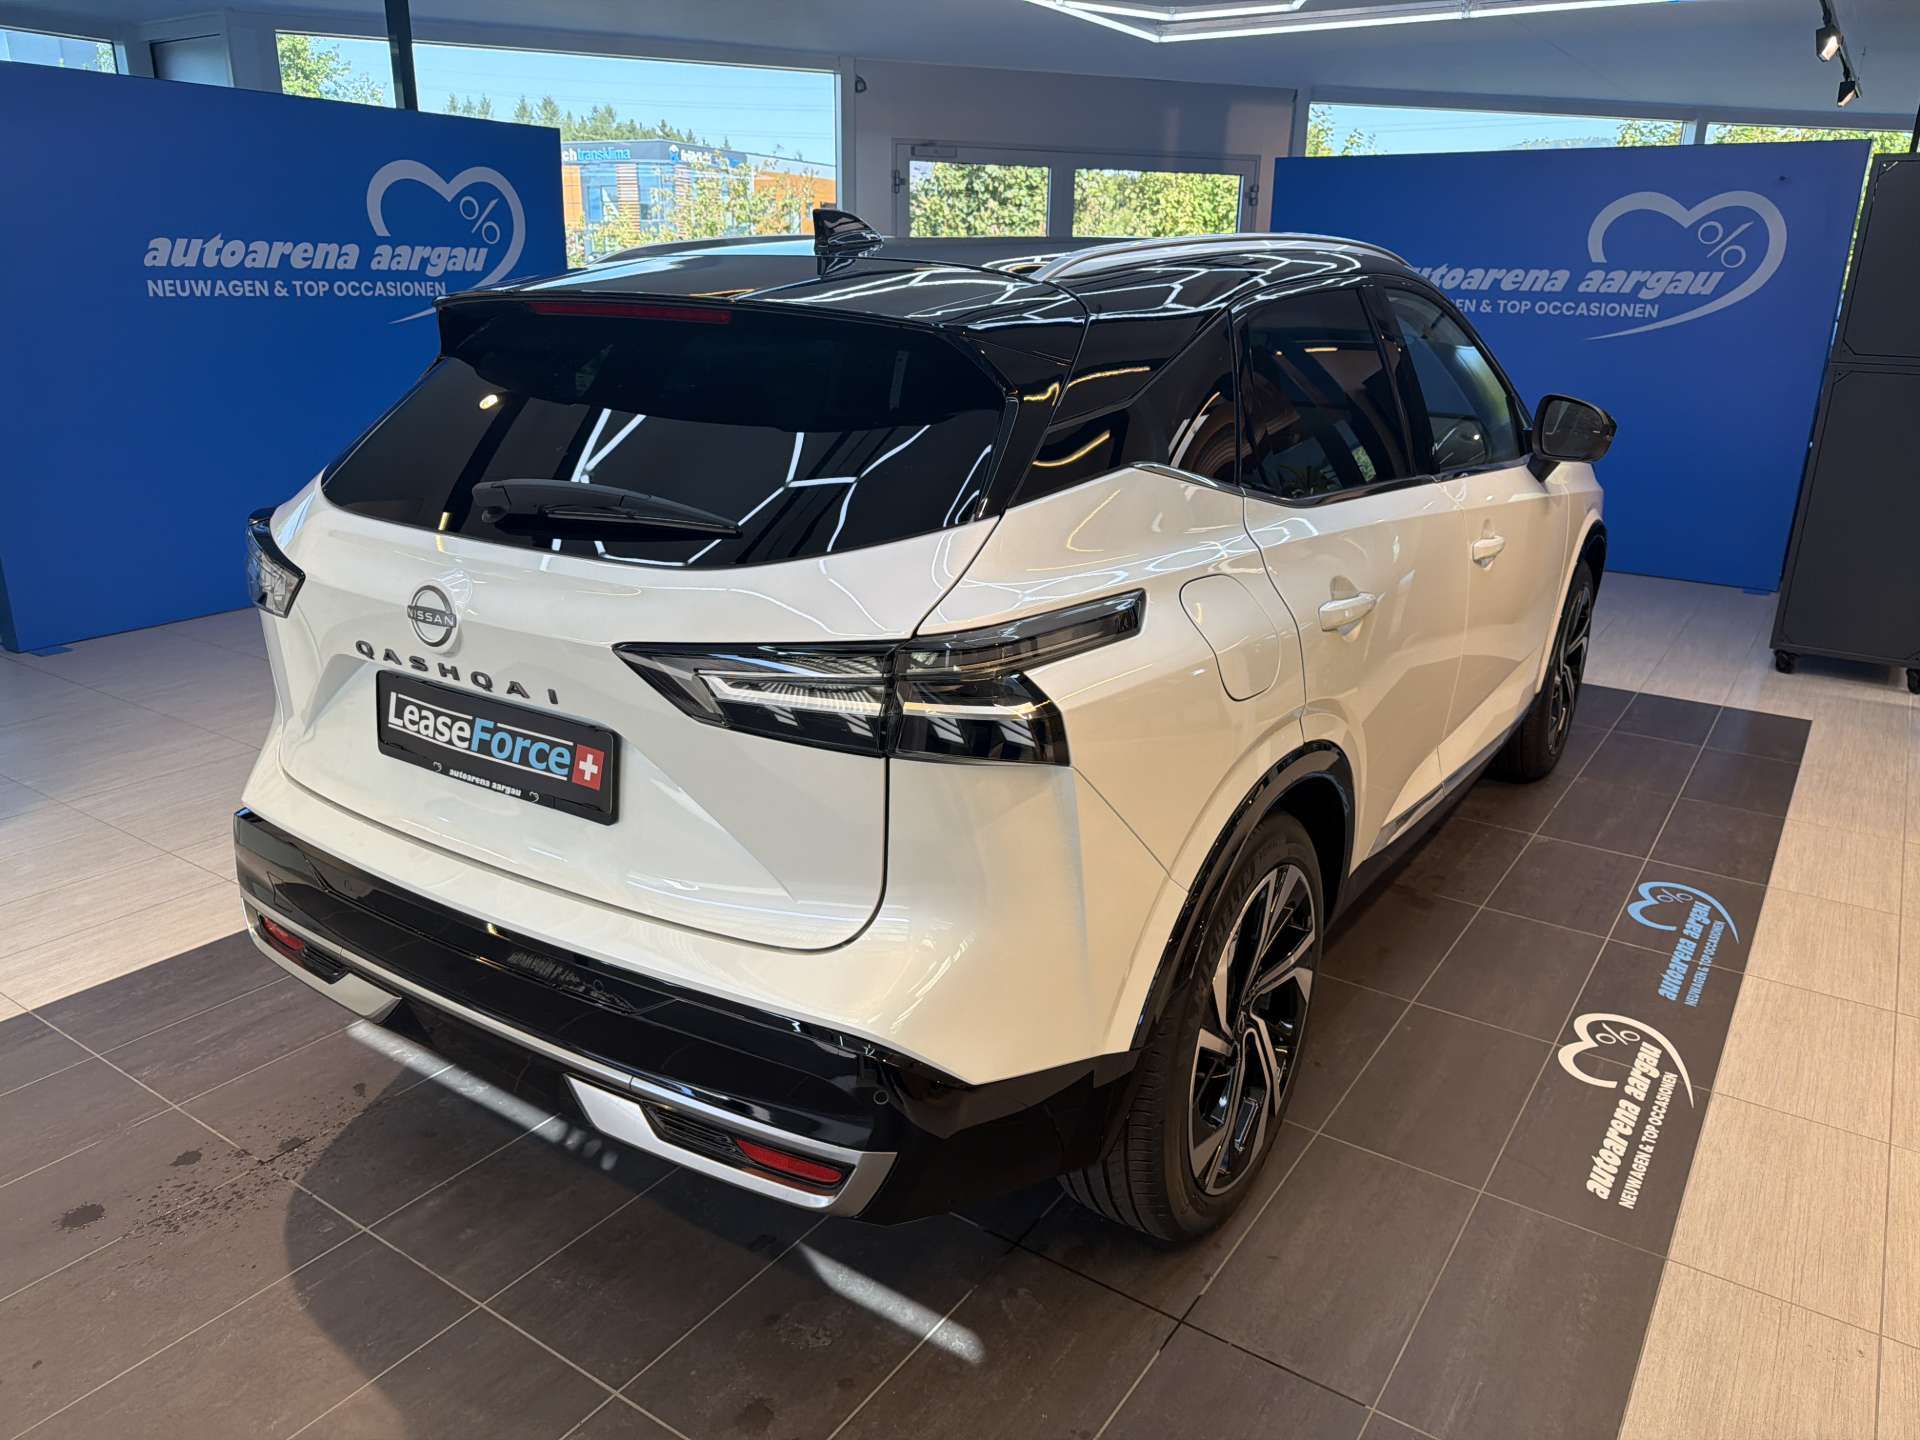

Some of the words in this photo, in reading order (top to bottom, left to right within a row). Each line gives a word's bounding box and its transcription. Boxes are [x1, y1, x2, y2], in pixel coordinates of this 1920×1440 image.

[143, 232, 360, 271] autoarena
[370, 244, 489, 277] aargau
[146, 279, 270, 298] NEUWAGEN
[273, 281, 290, 298] &
[291, 280, 330, 298] TOP
[333, 281, 447, 298] OCCASIONEN
[1577, 269, 1725, 300] aargau
[1497, 299, 1532, 316] TOP
[1534, 301, 1659, 319] OCCASIONEN
[407, 606, 455, 626] NISSAN
[355, 640, 559, 705] QASHQAI
[387, 691, 572, 777] LeaseForce
[449, 768, 491, 788] autoarena
[492, 780, 522, 797] aargau
[1658, 938, 1698, 1001] autoarena
[1683, 900, 1712, 940] aargau
[1586, 1098, 1642, 1200] autoarena
[1624, 1041, 1663, 1102] aargau
[1648, 1071, 1679, 1127] OCCASIONEN
[1641, 1124, 1660, 1145] TOP
[1618, 1151, 1652, 1210] NEUWAGEN
